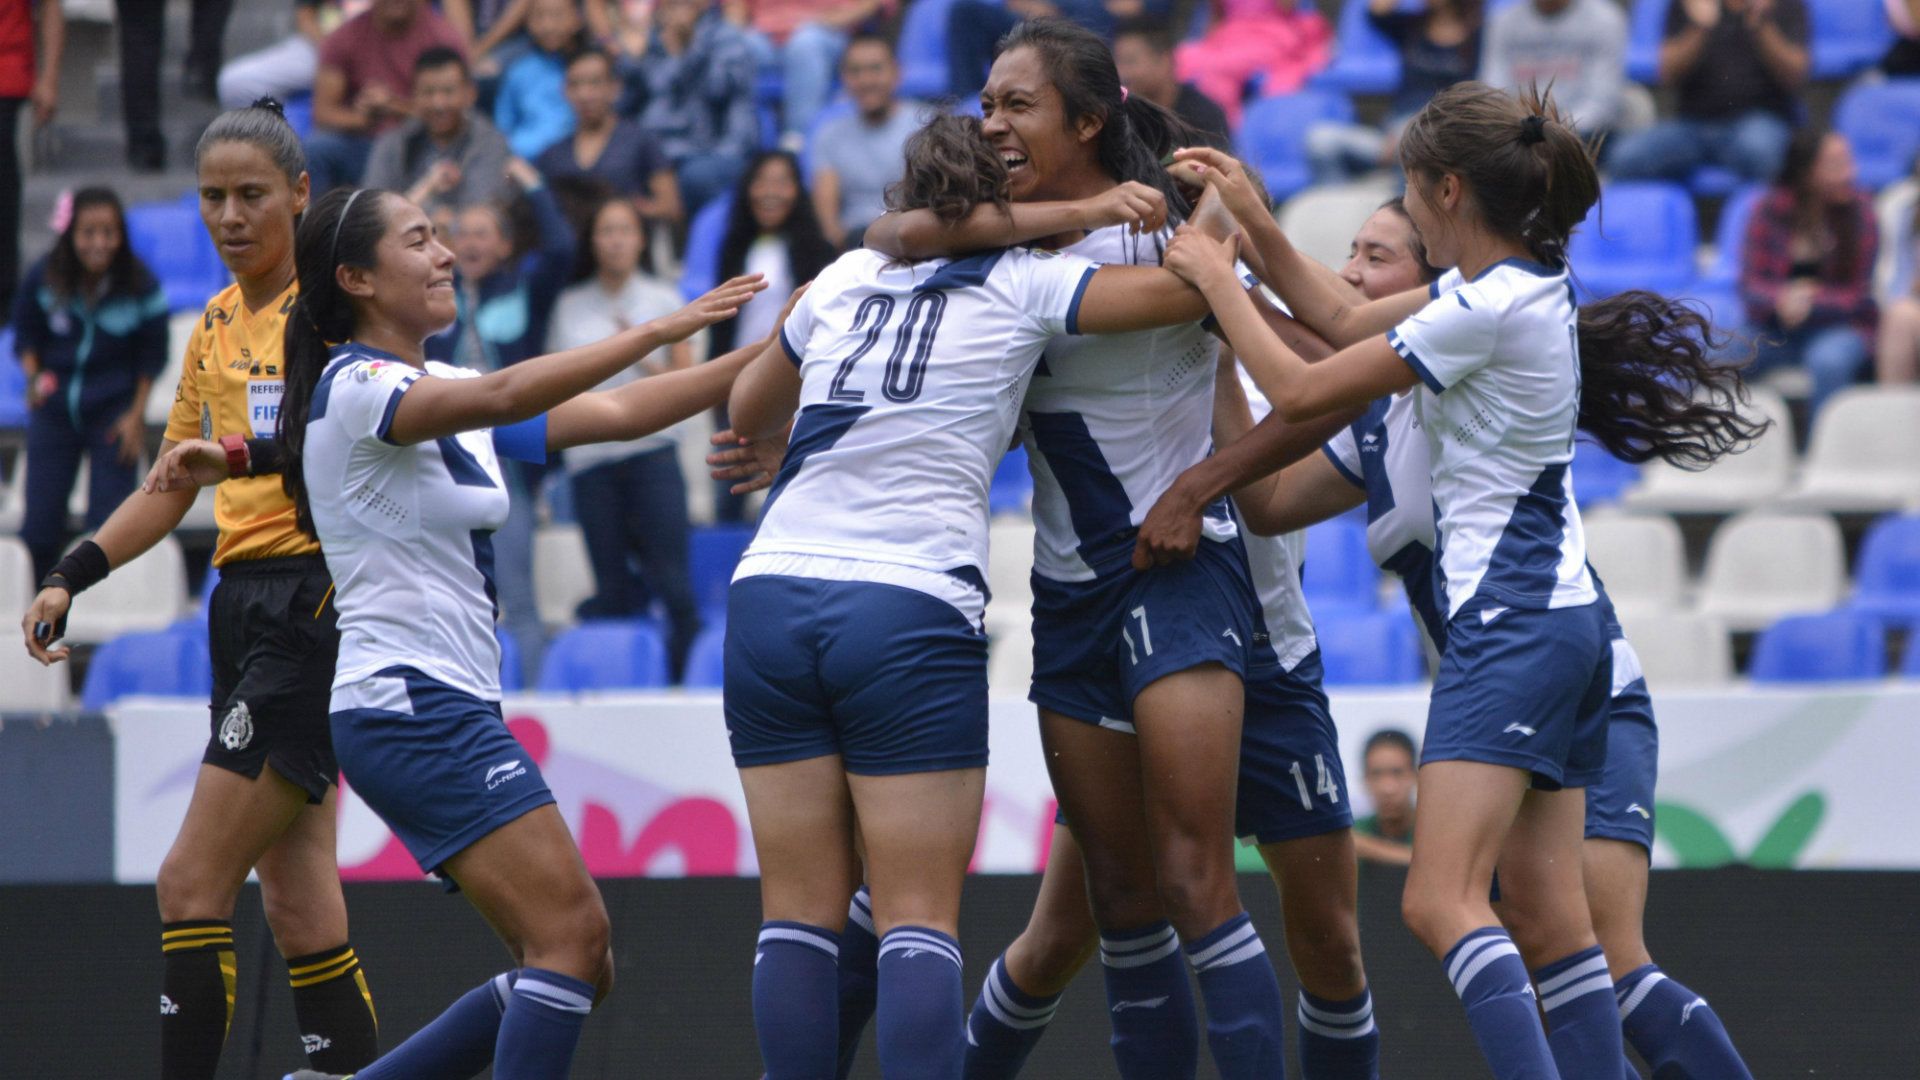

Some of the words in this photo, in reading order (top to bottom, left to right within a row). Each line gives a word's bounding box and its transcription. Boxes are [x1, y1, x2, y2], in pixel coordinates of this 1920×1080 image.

[827, 289, 948, 404] 20
[250, 384, 286, 394] REFERE
[254, 405, 279, 420] FIF
[1122, 605, 1153, 666] 17
[1288, 753, 1339, 811] 14
